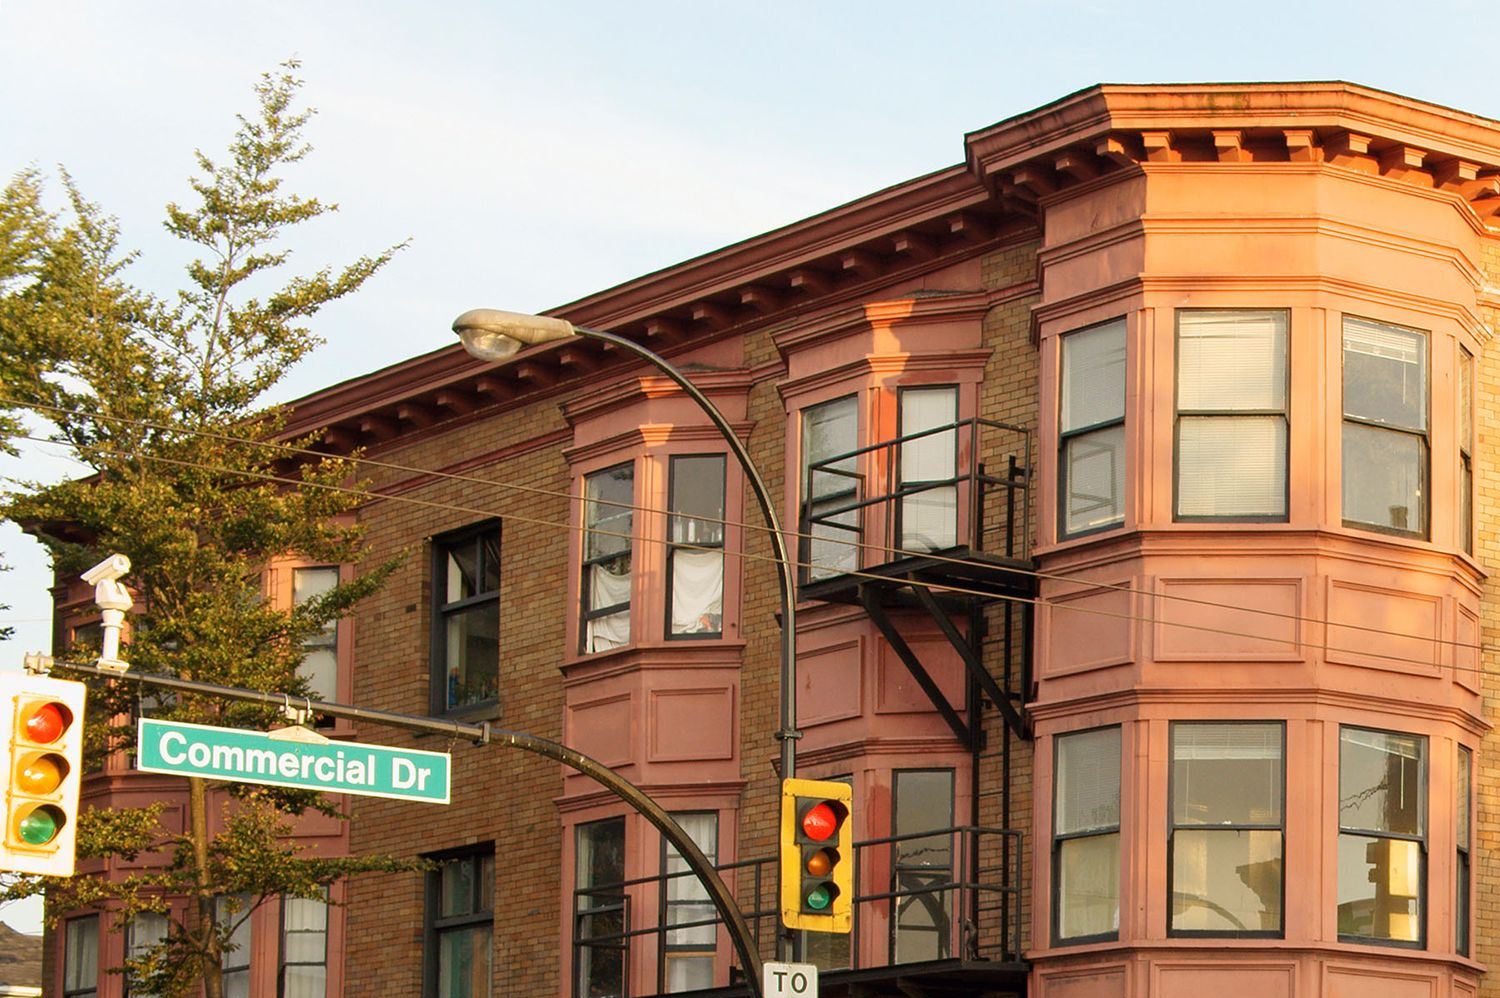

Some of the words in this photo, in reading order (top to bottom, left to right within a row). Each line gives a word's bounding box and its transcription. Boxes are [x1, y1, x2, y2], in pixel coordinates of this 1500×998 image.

[158, 730, 375, 786] Commercial
[392, 756, 431, 791] Dr
[773, 971, 808, 993] TO
